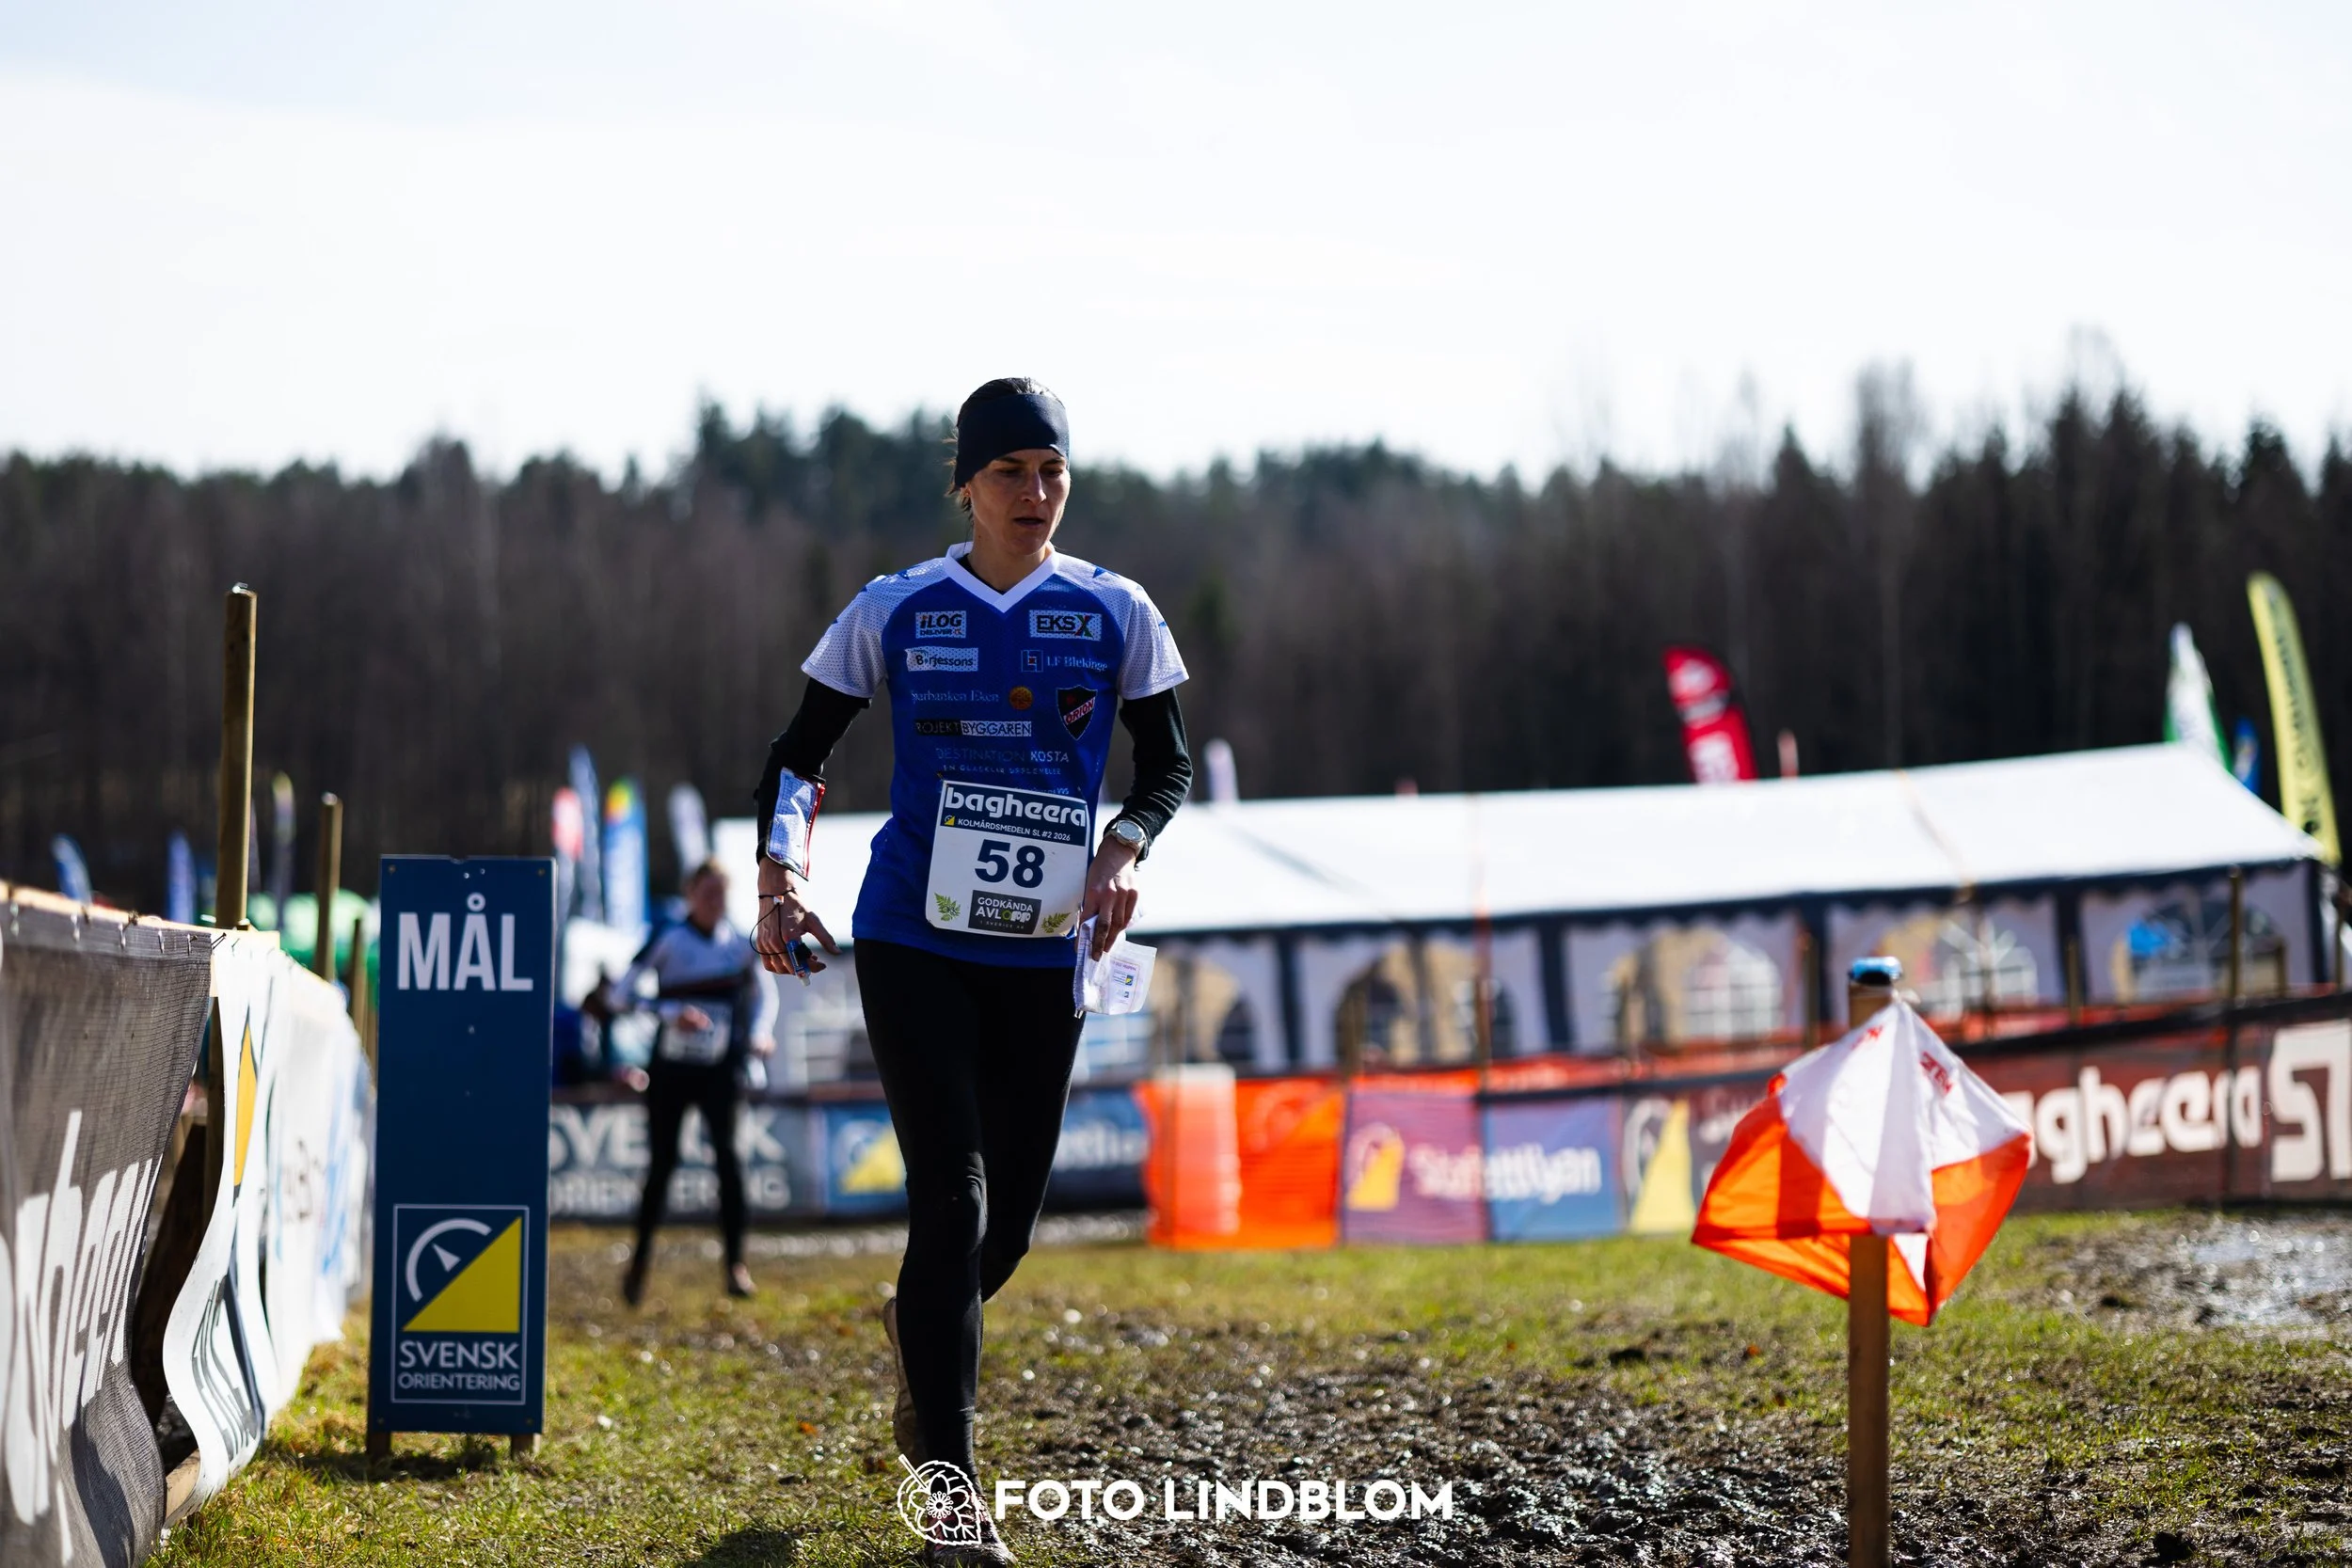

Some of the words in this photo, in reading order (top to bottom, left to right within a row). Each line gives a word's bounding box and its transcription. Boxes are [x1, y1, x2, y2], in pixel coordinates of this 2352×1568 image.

[1036, 614, 1094, 639] EKSX
[1065, 698, 1095, 725] ORION
[1030, 751, 1071, 764] KOSTA
[945, 786, 1087, 827] bagheera
[958, 818, 1031, 836] KOLMÅRDSMEDELN
[1032, 829, 1041, 838] SL
[1053, 832, 1072, 842] 2026
[975, 839, 1045, 889] 58
[977, 896, 1034, 912] GODKÄNDA
[396, 892, 533, 992] MÅL
[400, 1339, 520, 1370] SVENSK
[397, 1371, 521, 1391] ORIENTERING
